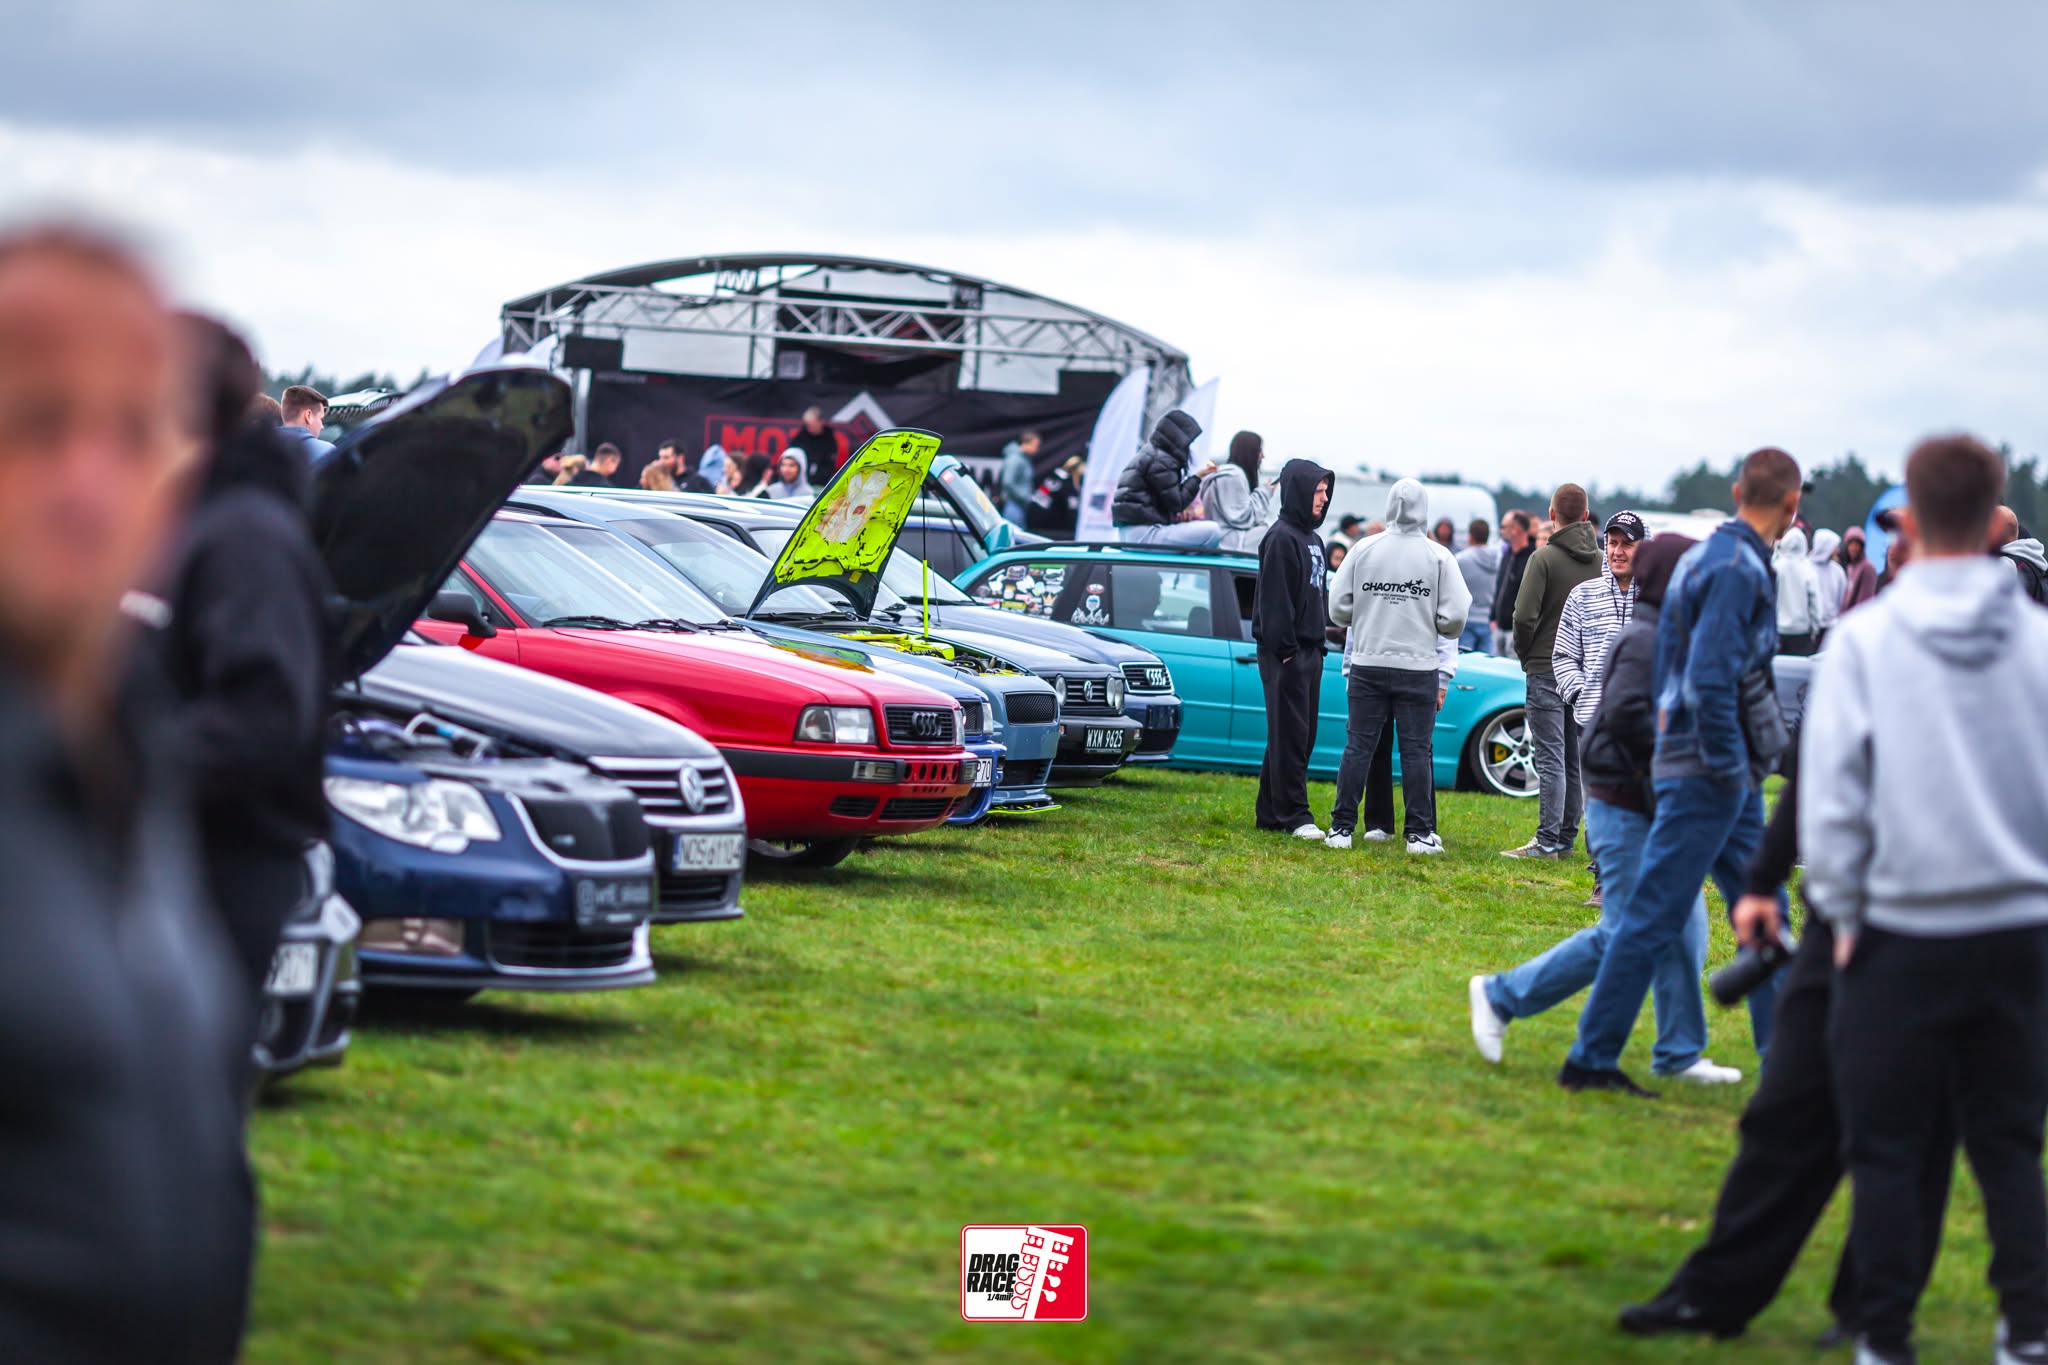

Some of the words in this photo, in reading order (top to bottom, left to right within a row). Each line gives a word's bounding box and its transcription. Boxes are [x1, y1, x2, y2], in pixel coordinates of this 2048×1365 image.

[721, 423, 850, 472] MO
[1362, 582, 1407, 593] CHAOTIC
[1410, 586, 1431, 597] SYS
[1086, 729, 1104, 747] WXM
[1105, 729, 1124, 748] 9625
